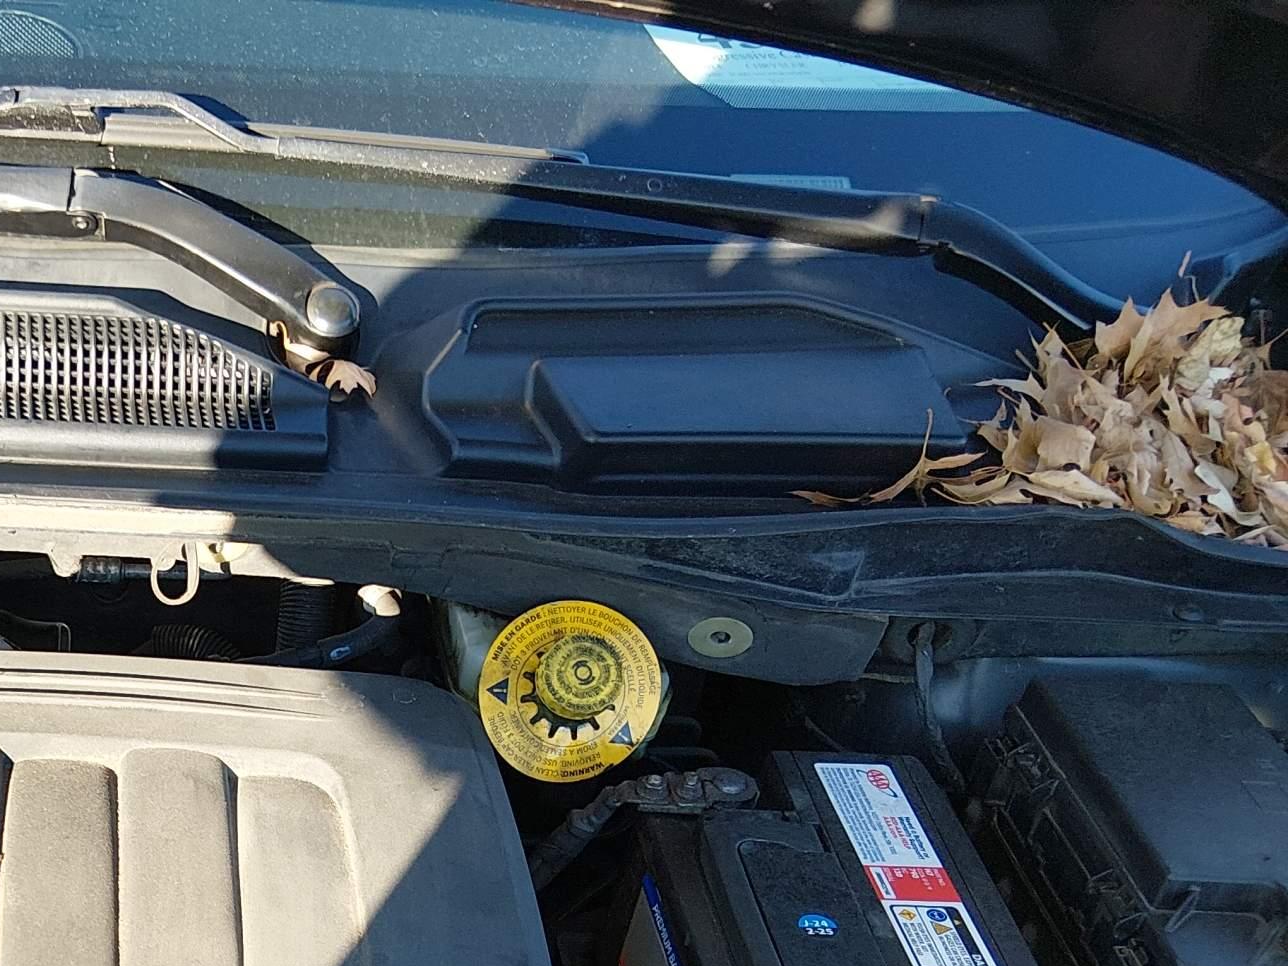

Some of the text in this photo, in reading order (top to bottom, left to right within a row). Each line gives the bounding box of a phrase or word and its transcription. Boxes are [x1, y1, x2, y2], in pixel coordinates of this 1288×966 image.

[491, 606, 657, 696] MISE EN GARDE NETTOYER LE BOUCHON DE REMPLISSAGE
[511, 657, 522, 671] DOT
[524, 626, 569, 653] PROVENANT
[516, 633, 528, 645] DE
[526, 626, 536, 638] LE
[569, 616, 603, 629] UTILISER
[603, 624, 641, 665] UNIQUEMENT
[651, 903, 674, 954] PREMIUM
[805, 928, 834, 936] 2-25
